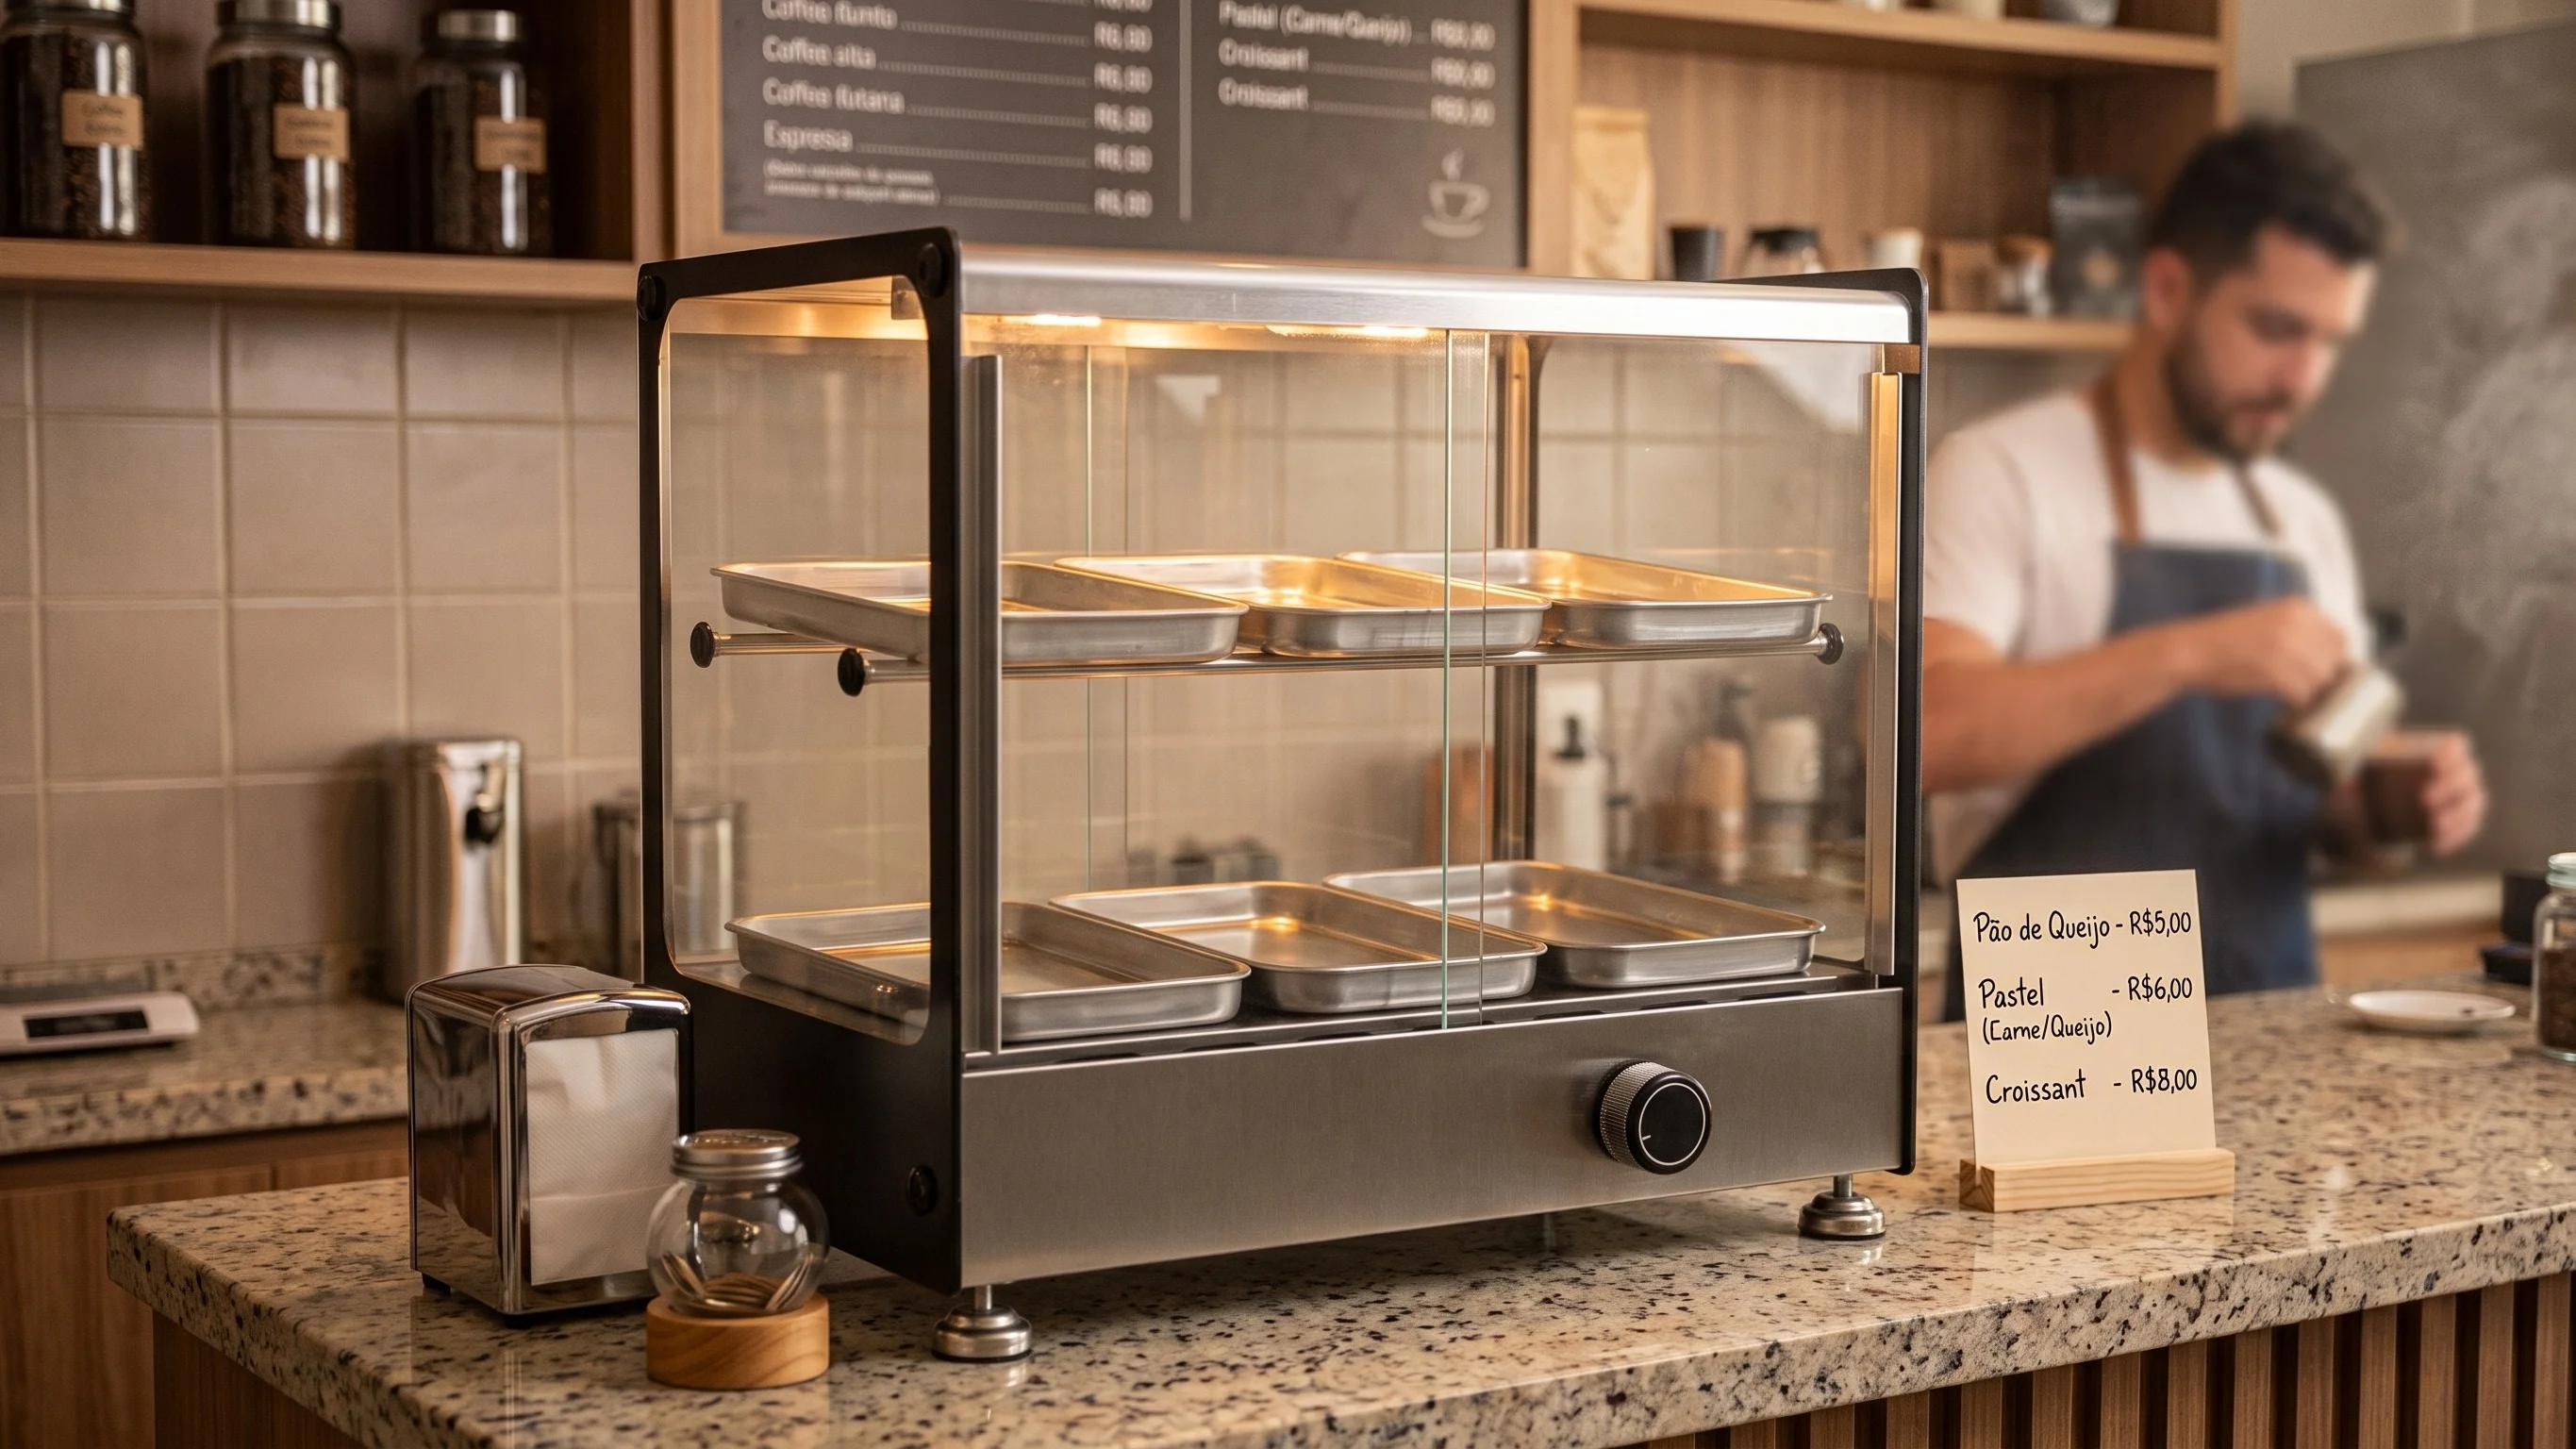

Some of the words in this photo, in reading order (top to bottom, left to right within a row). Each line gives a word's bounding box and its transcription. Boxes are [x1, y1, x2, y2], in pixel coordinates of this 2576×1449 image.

[1973, 911, 2012, 942] Pão
[2019, 912, 2042, 941] de
[2048, 910, 2110, 949] Queijo
[2129, 908, 2192, 938] R$5,00
[1978, 977, 2044, 1008] Pastel
[2127, 973, 2193, 1003] R$6,00
[1986, 1068, 2086, 1104] Croissant
[2131, 1065, 2198, 1094] R$8,00
